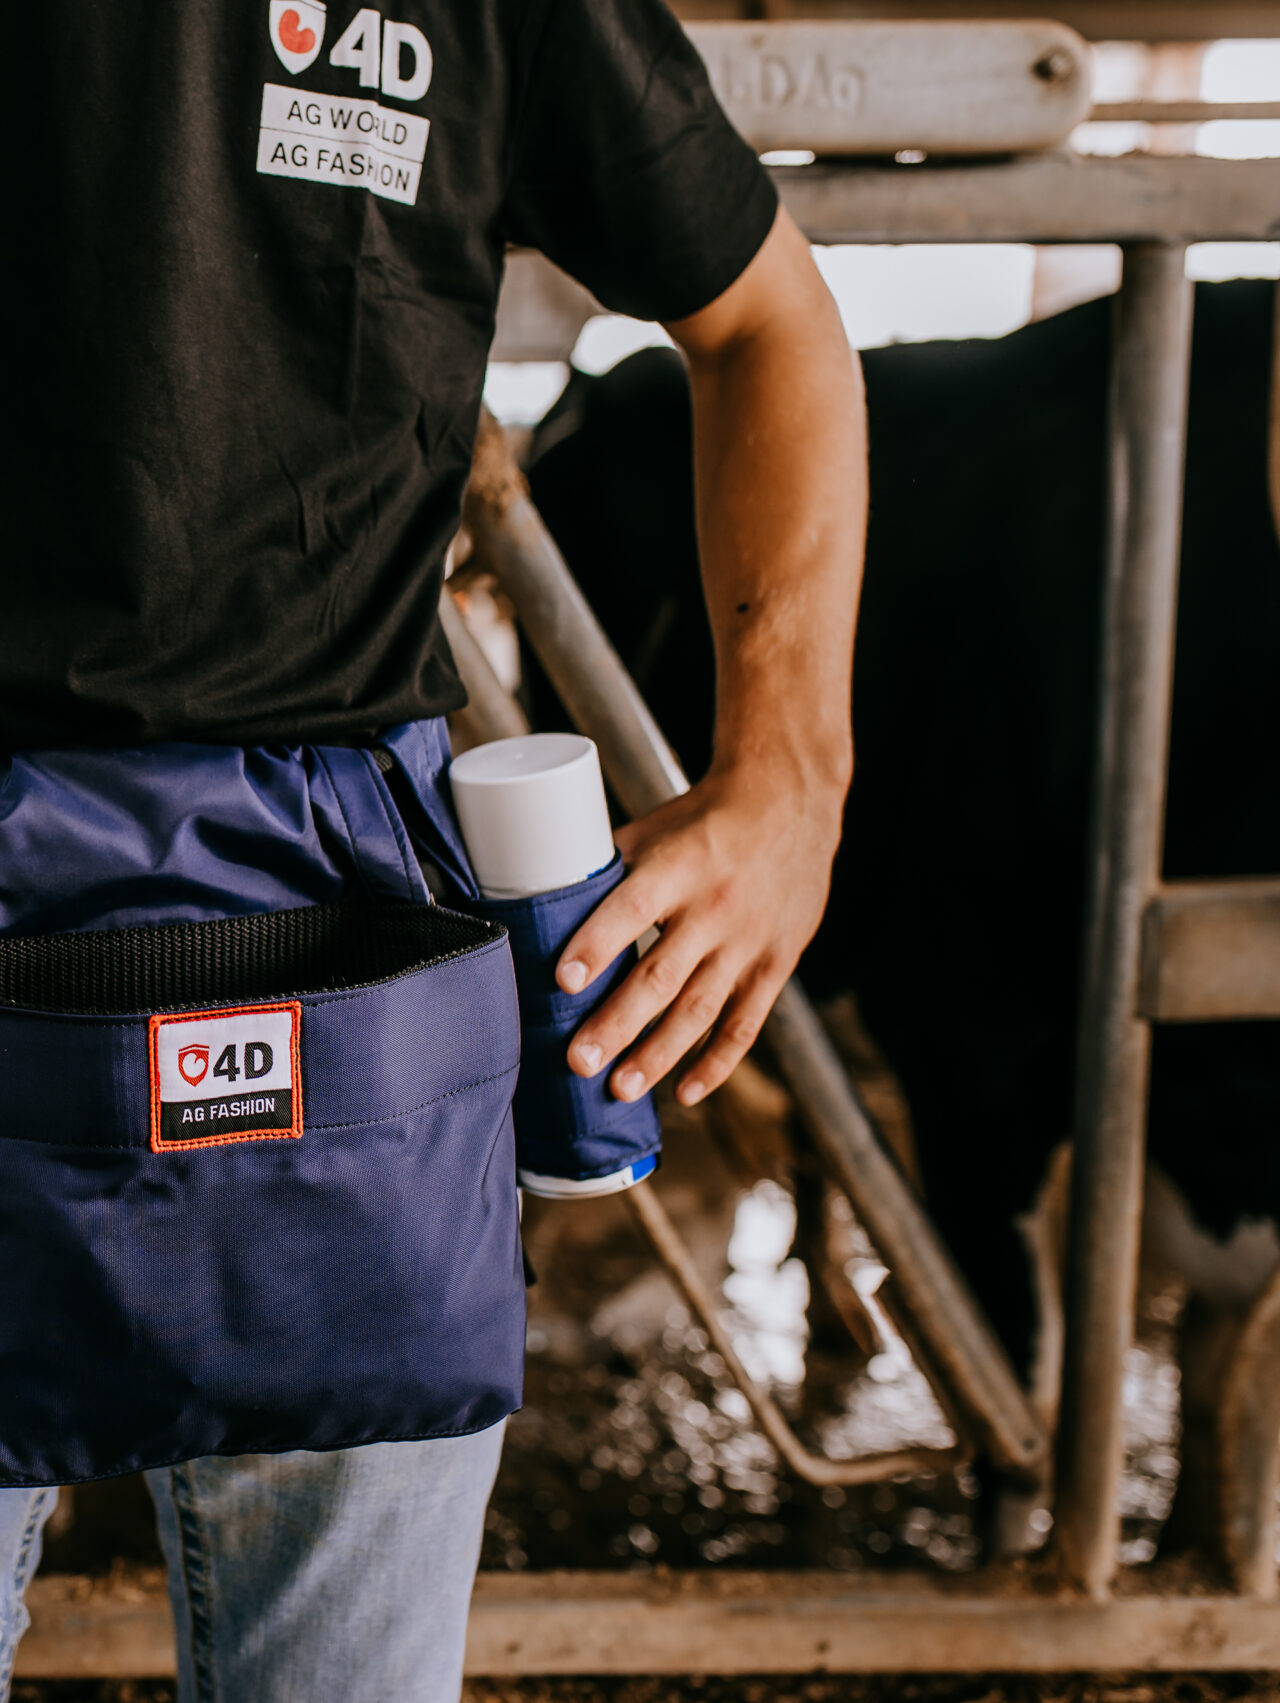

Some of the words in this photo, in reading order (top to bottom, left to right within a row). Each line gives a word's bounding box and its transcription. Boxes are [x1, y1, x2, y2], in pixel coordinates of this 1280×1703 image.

[328, 7, 434, 102] 4D
[287, 99, 321, 126] AG
[329, 107, 408, 146] WORLD
[269, 141, 309, 168] AG
[316, 148, 411, 192] FASHION
[212, 1041, 275, 1083] 4D
[181, 1106, 206, 1124] AG
[209, 1097, 276, 1121] FASHION
